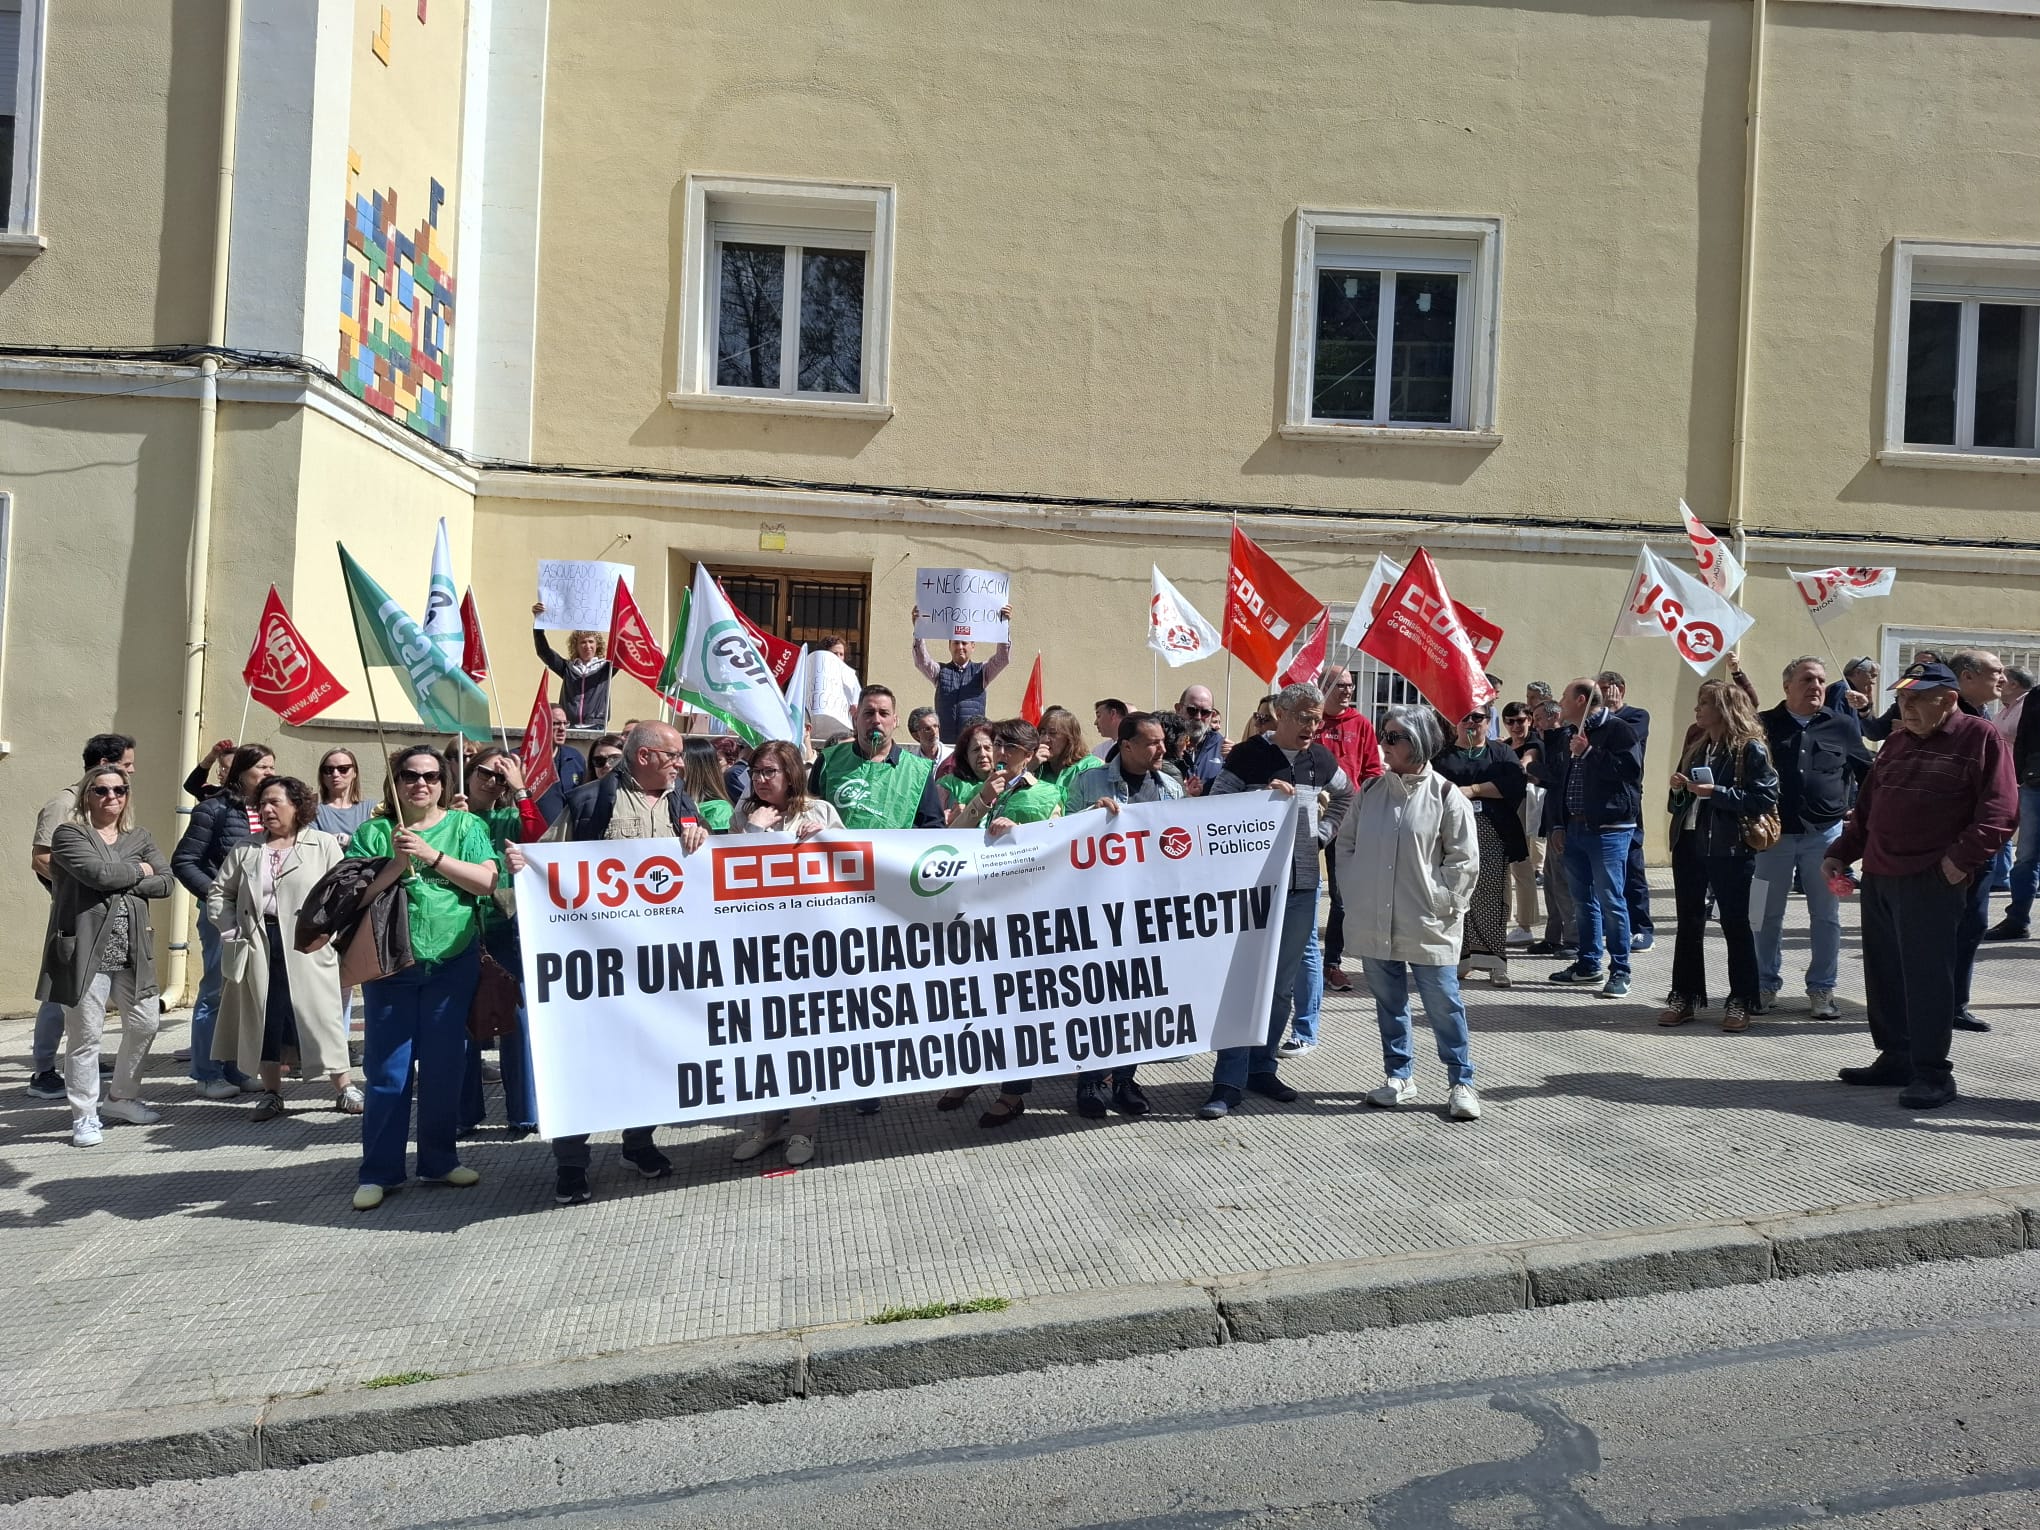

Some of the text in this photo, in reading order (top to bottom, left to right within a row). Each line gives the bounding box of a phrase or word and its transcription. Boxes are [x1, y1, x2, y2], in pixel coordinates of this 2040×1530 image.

[542, 563, 597, 579] ASQUEADO
[542, 608, 609, 626] NEGOCIA
[1387, 618, 1399, 629] de
[712, 635, 769, 685] CSI
[773, 648, 792, 678] ugt.es
[281, 681, 332, 718] www.ugt.es
[1207, 818, 1276, 838] Servicios
[980, 845, 1039, 860] Central Sindical
[1070, 829, 1151, 870] UGT
[1209, 838, 1271, 856] Públicos
[724, 850, 865, 890] CCOO
[921, 860, 968, 879] CSIF
[1001, 865, 1046, 877] Funcionarios
[547, 855, 684, 910] USO
[549, 905, 685, 923] UNIÓN SINDICAL OBRERA
[714, 893, 876, 915] servicios a la ciudadanía
[536, 884, 1278, 1003] POR UNA NEGOCIACIÓN REAL Y EFECTIV
[707, 955, 1169, 1046] EN DEFENSA DEL PERSONAL
[677, 1003, 1197, 1109] DE LA DIPUTACIÓN DE CUENCA
